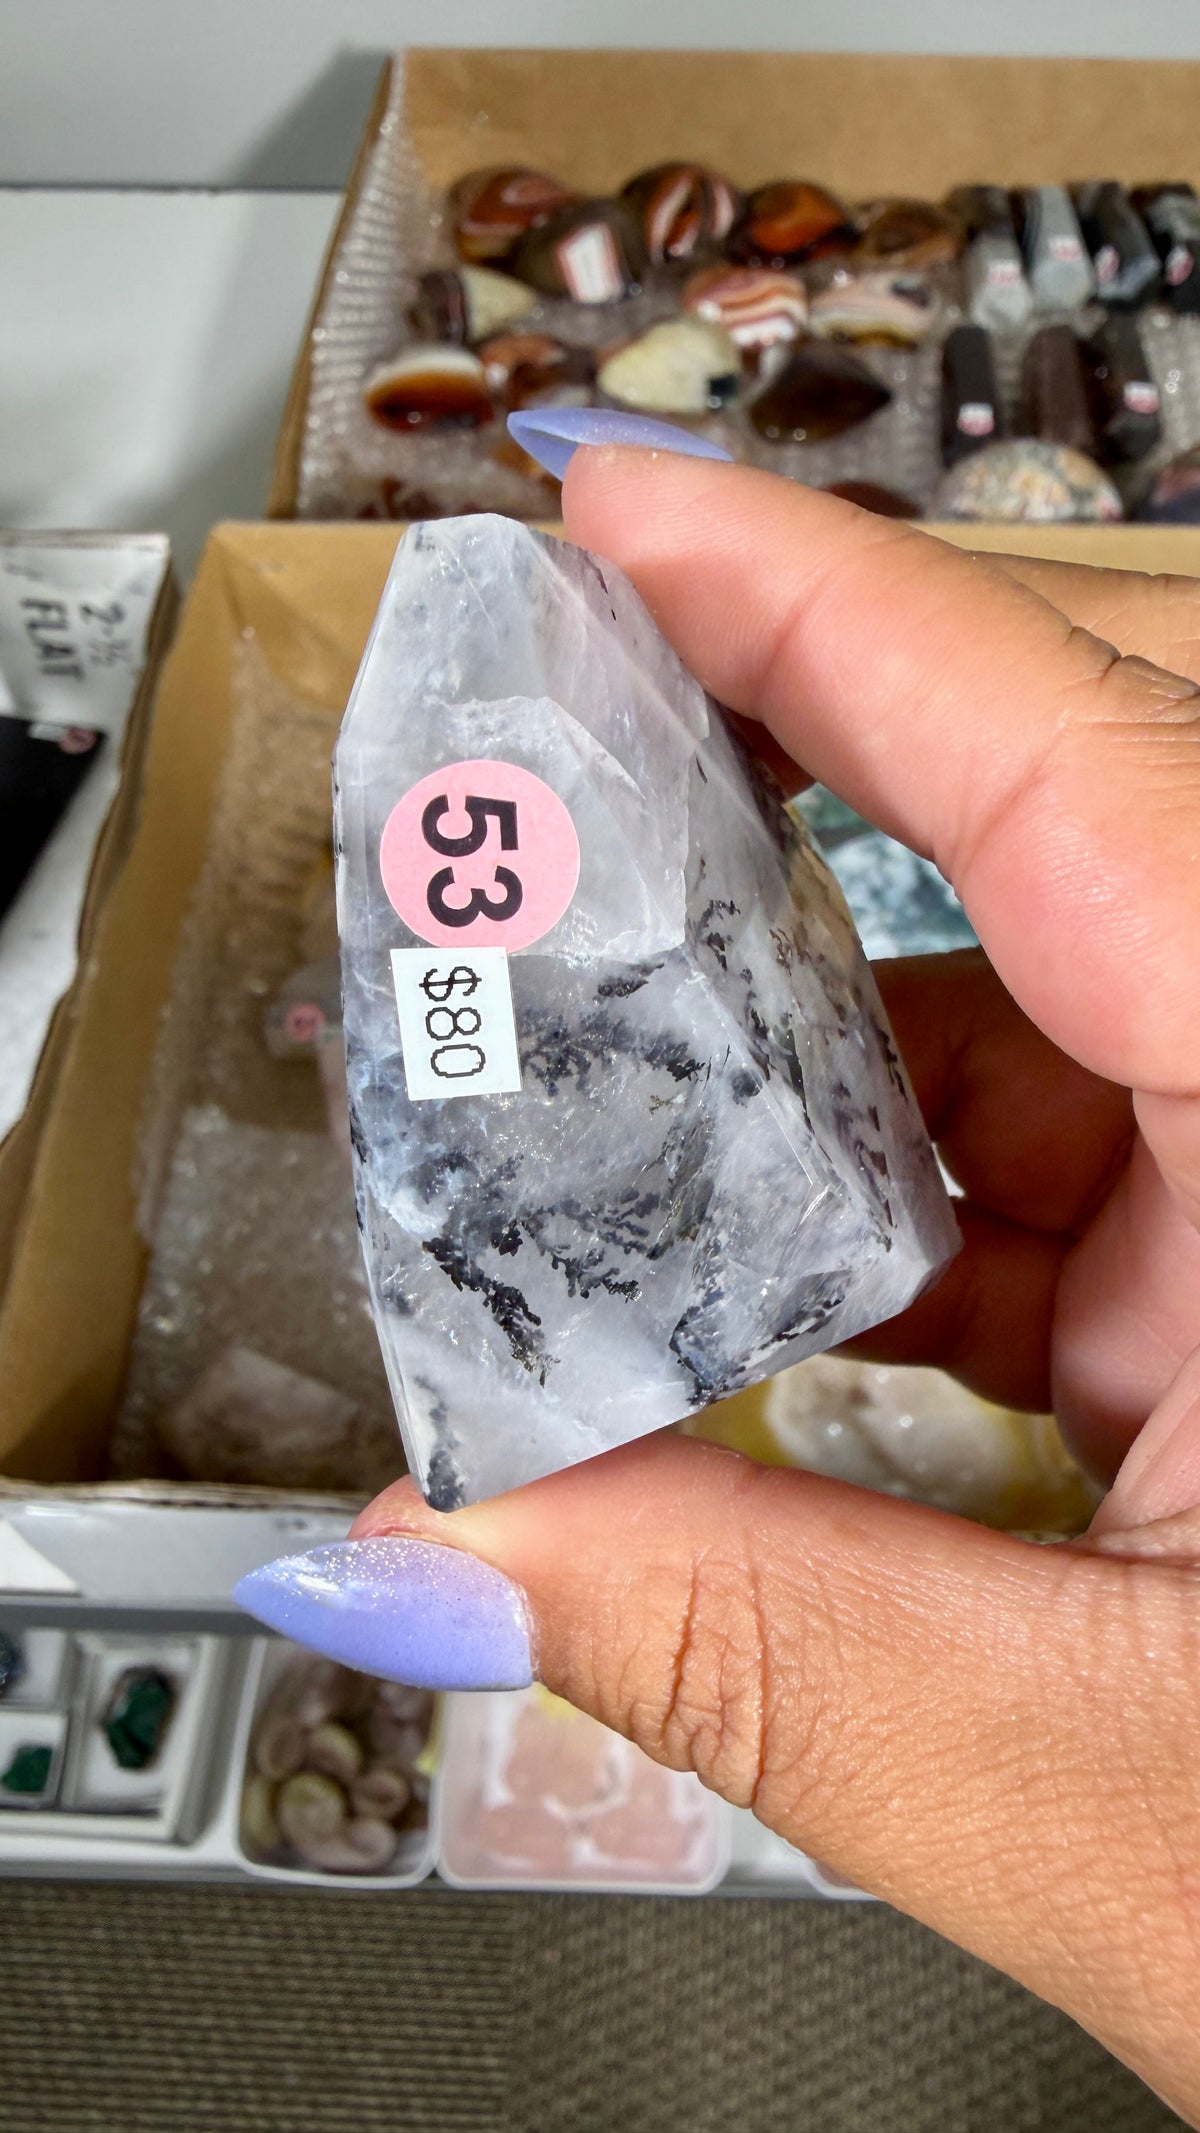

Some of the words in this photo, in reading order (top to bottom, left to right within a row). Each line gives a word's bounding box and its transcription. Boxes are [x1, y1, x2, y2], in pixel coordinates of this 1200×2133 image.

[20, 598, 86, 682] FLAT
[421, 793, 523, 928] 53
[418, 966, 486, 1078] $80
